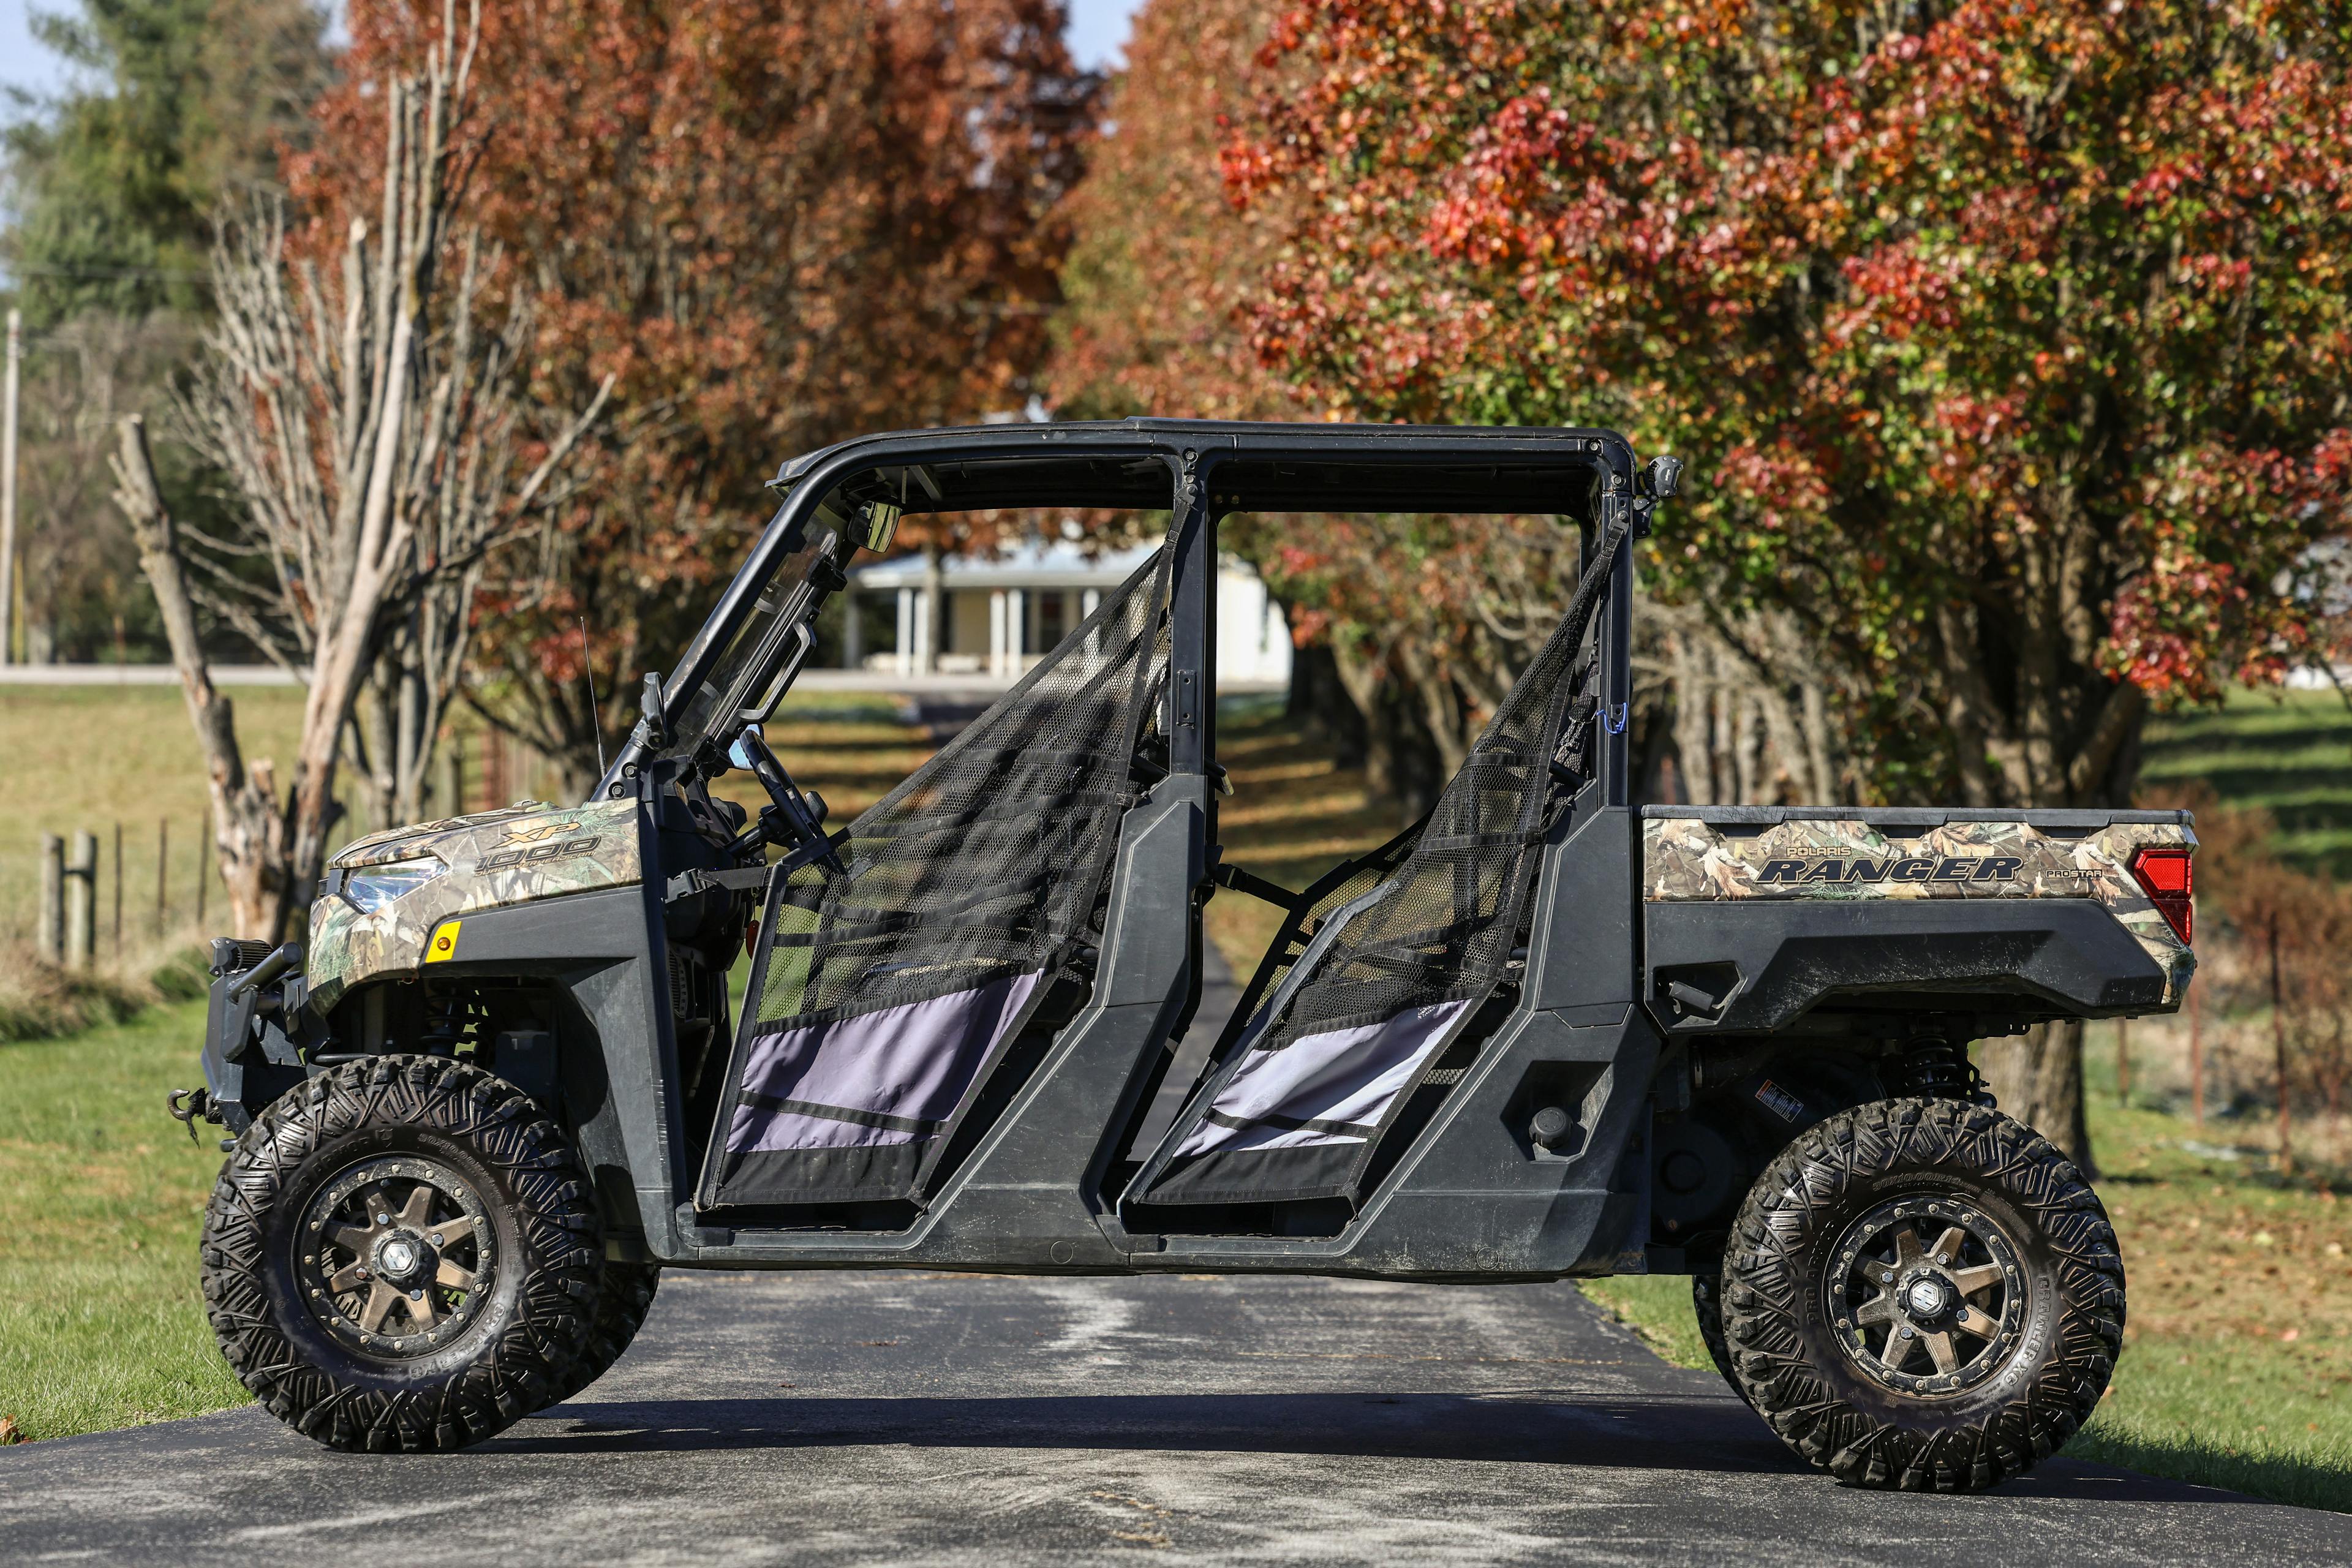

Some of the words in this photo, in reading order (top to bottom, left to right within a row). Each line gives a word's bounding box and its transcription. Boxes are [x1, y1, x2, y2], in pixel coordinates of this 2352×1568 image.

[488, 822, 581, 850] XP
[474, 835, 601, 872] 1000
[1787, 846, 1851, 856] POLARIS
[474, 866, 505, 877] DUAL
[508, 856, 567, 870] OVERHEAD
[1754, 856, 2023, 883] RANGER
[1805, 1287, 1820, 1324] PRO
[2023, 1276, 2051, 1362] CRAWLER
[2005, 1362, 2028, 1385] XG
